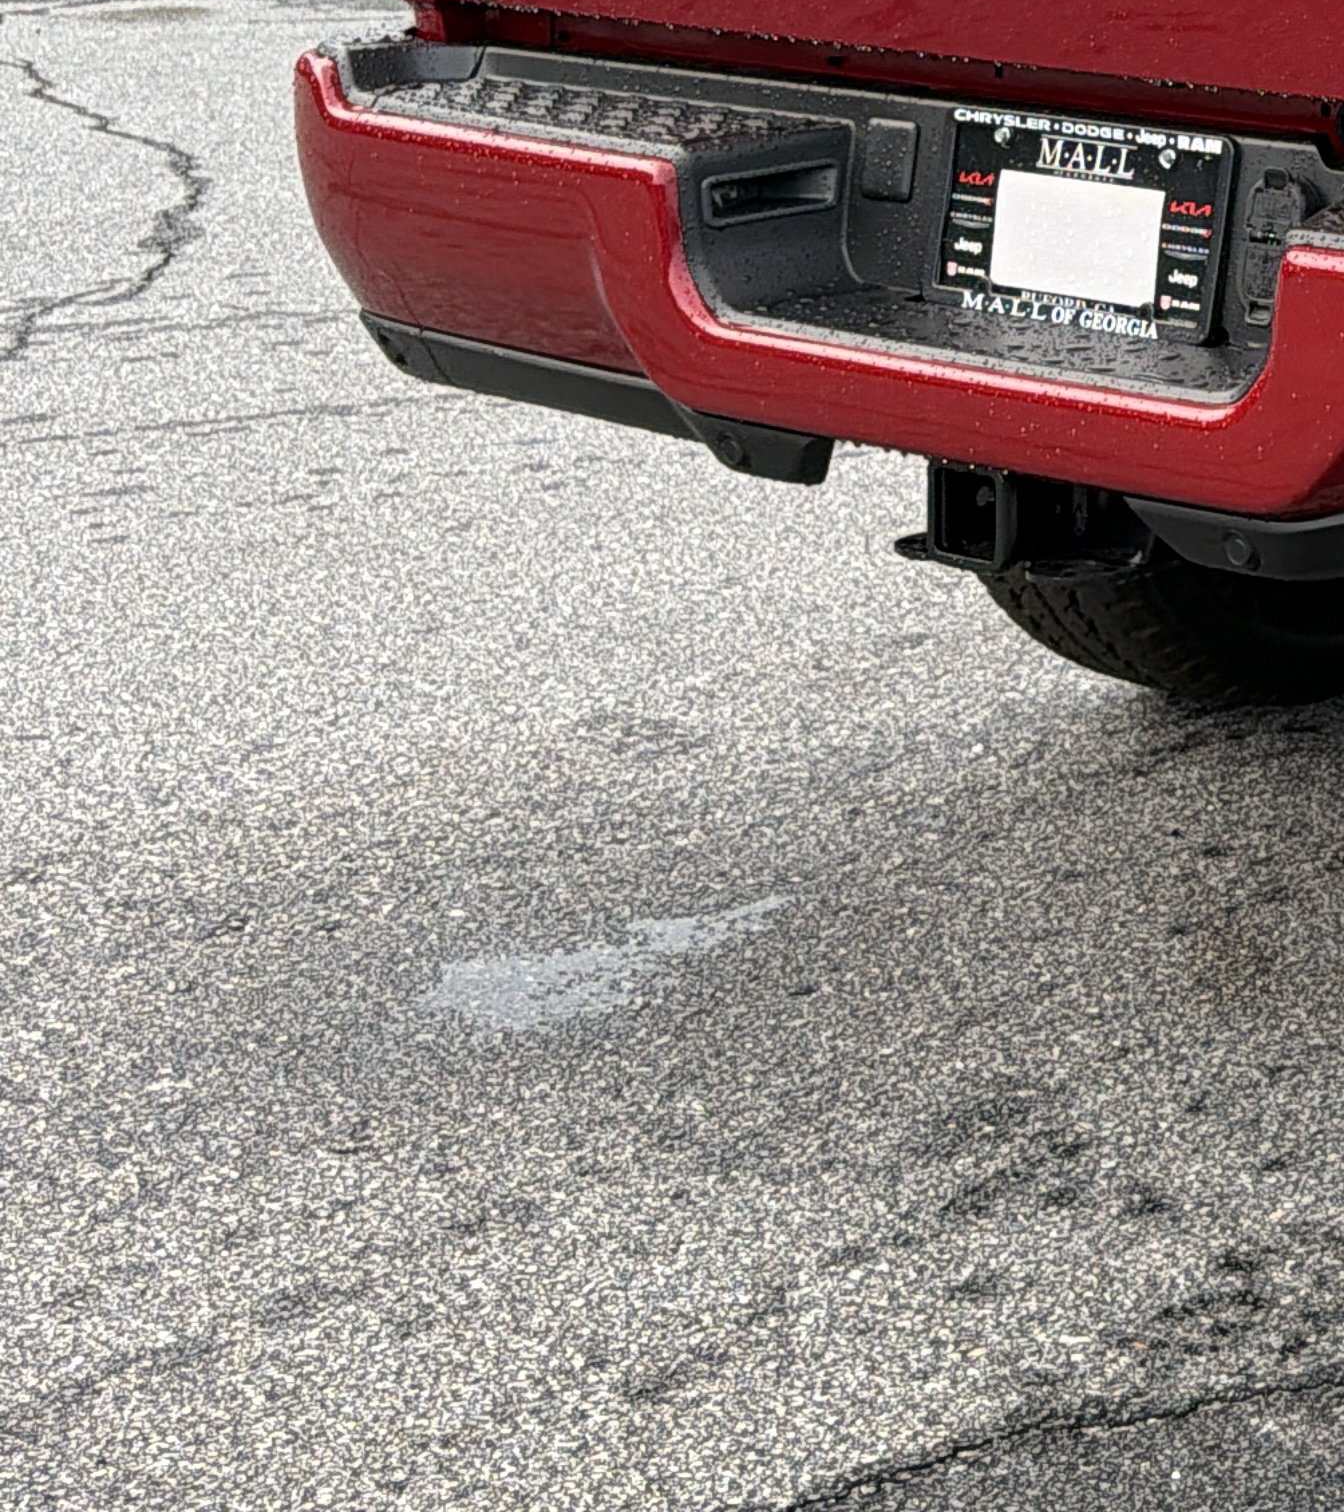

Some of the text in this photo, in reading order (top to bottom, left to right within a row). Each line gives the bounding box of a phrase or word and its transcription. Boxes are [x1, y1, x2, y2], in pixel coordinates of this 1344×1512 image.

[954, 108, 1223, 155] CHRYSLER DODGE Jeep RAM
[1051, 306, 1075, 325] OF
[1079, 310, 1159, 339] GEORGIA
